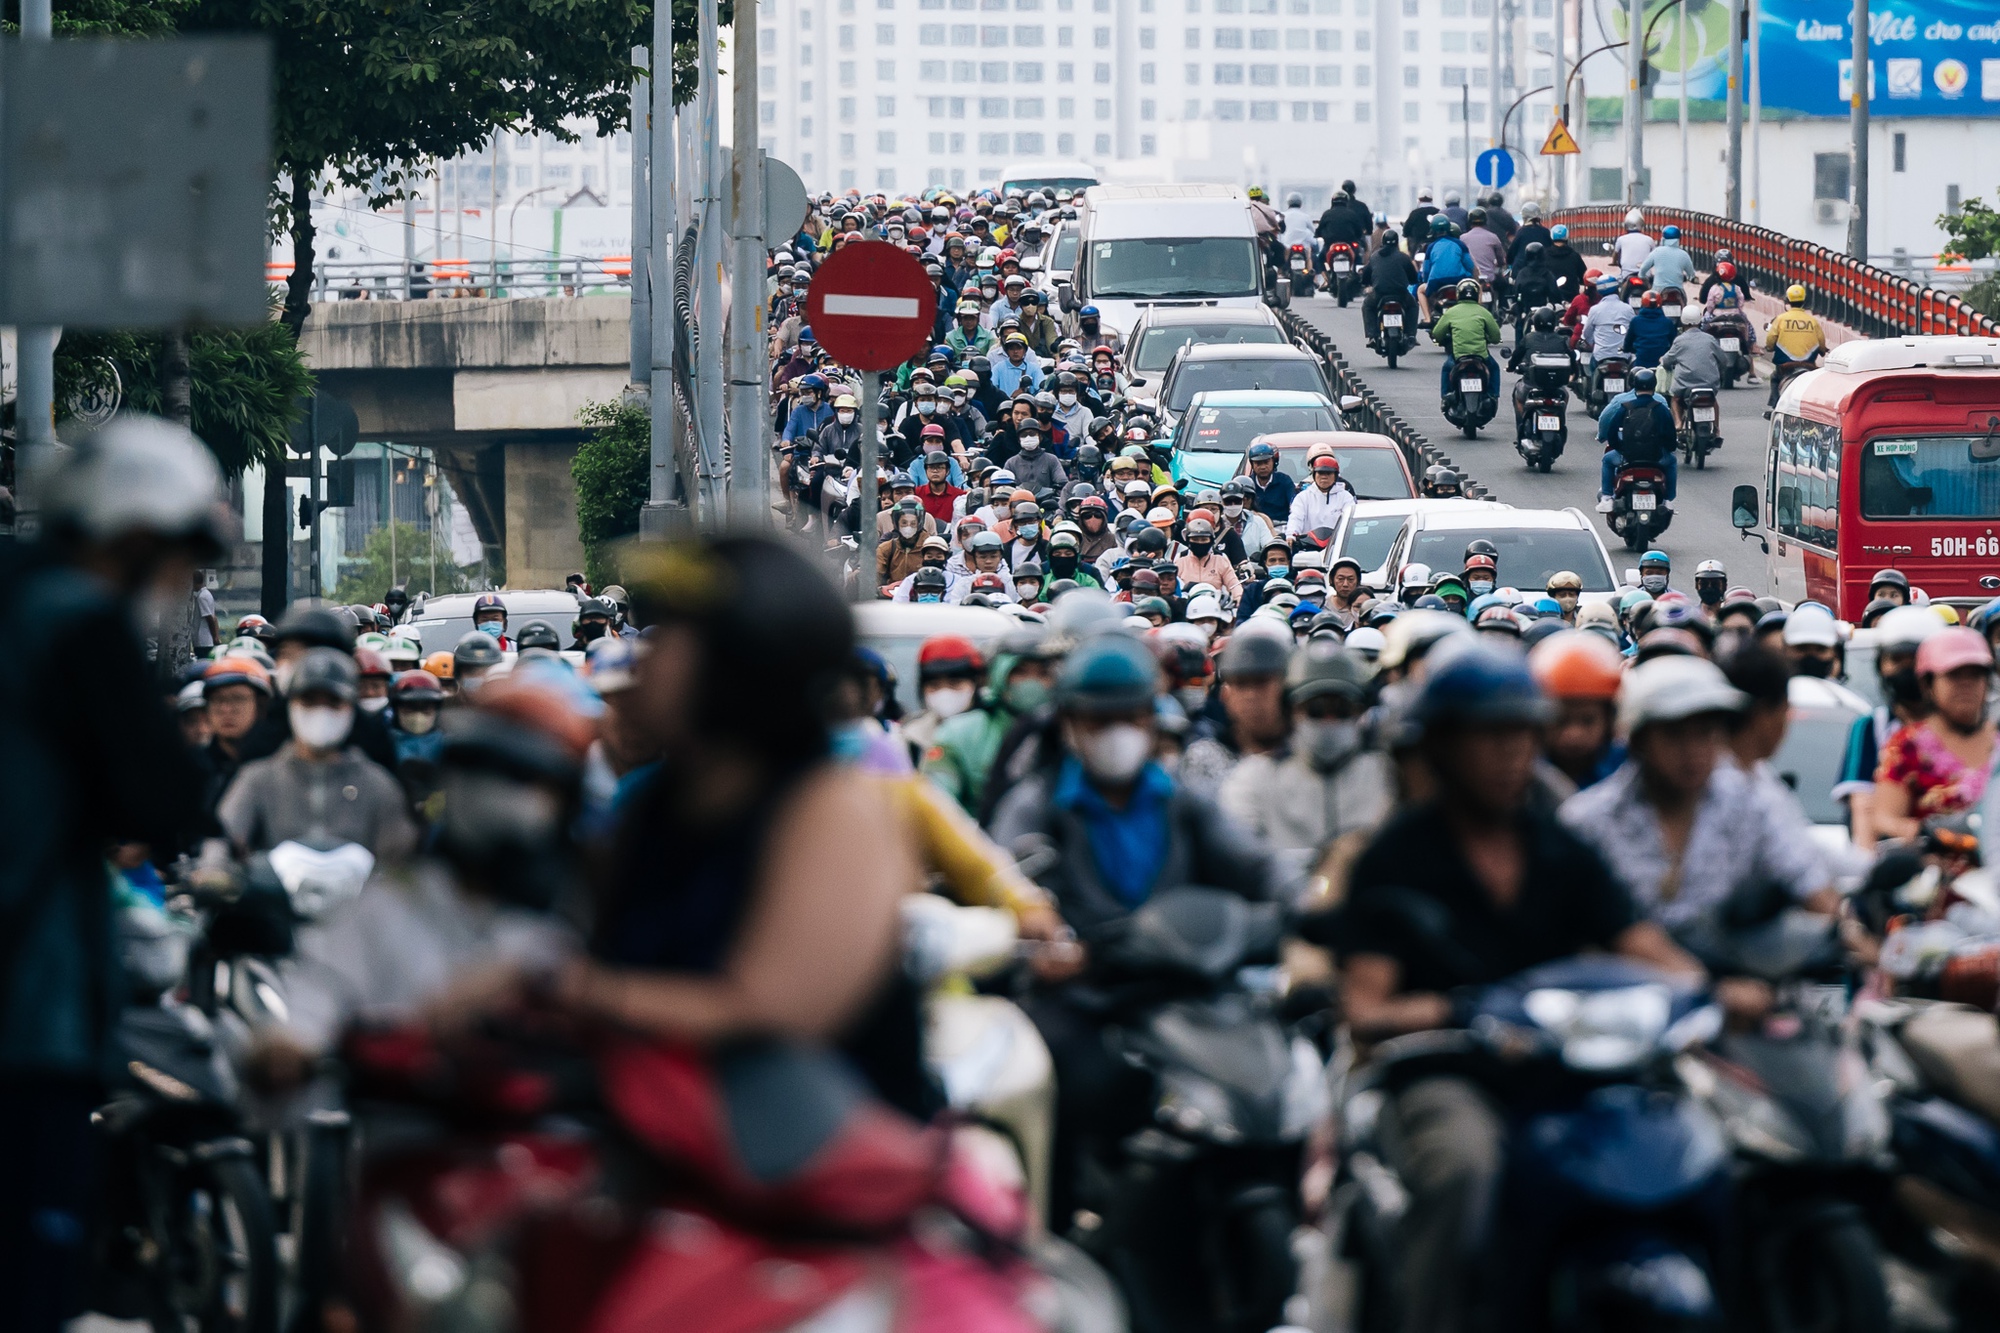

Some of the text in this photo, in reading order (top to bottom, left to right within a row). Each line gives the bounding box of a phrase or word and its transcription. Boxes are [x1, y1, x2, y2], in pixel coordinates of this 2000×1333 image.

[1796, 19, 1843, 41] Làm
[1924, 20, 1963, 40] cho
[1785, 319, 1814, 331] TADA
[1876, 445, 1884, 453] XE
[1863, 545, 1912, 554] THACO
[1931, 537, 2000, 557] 50H-66
